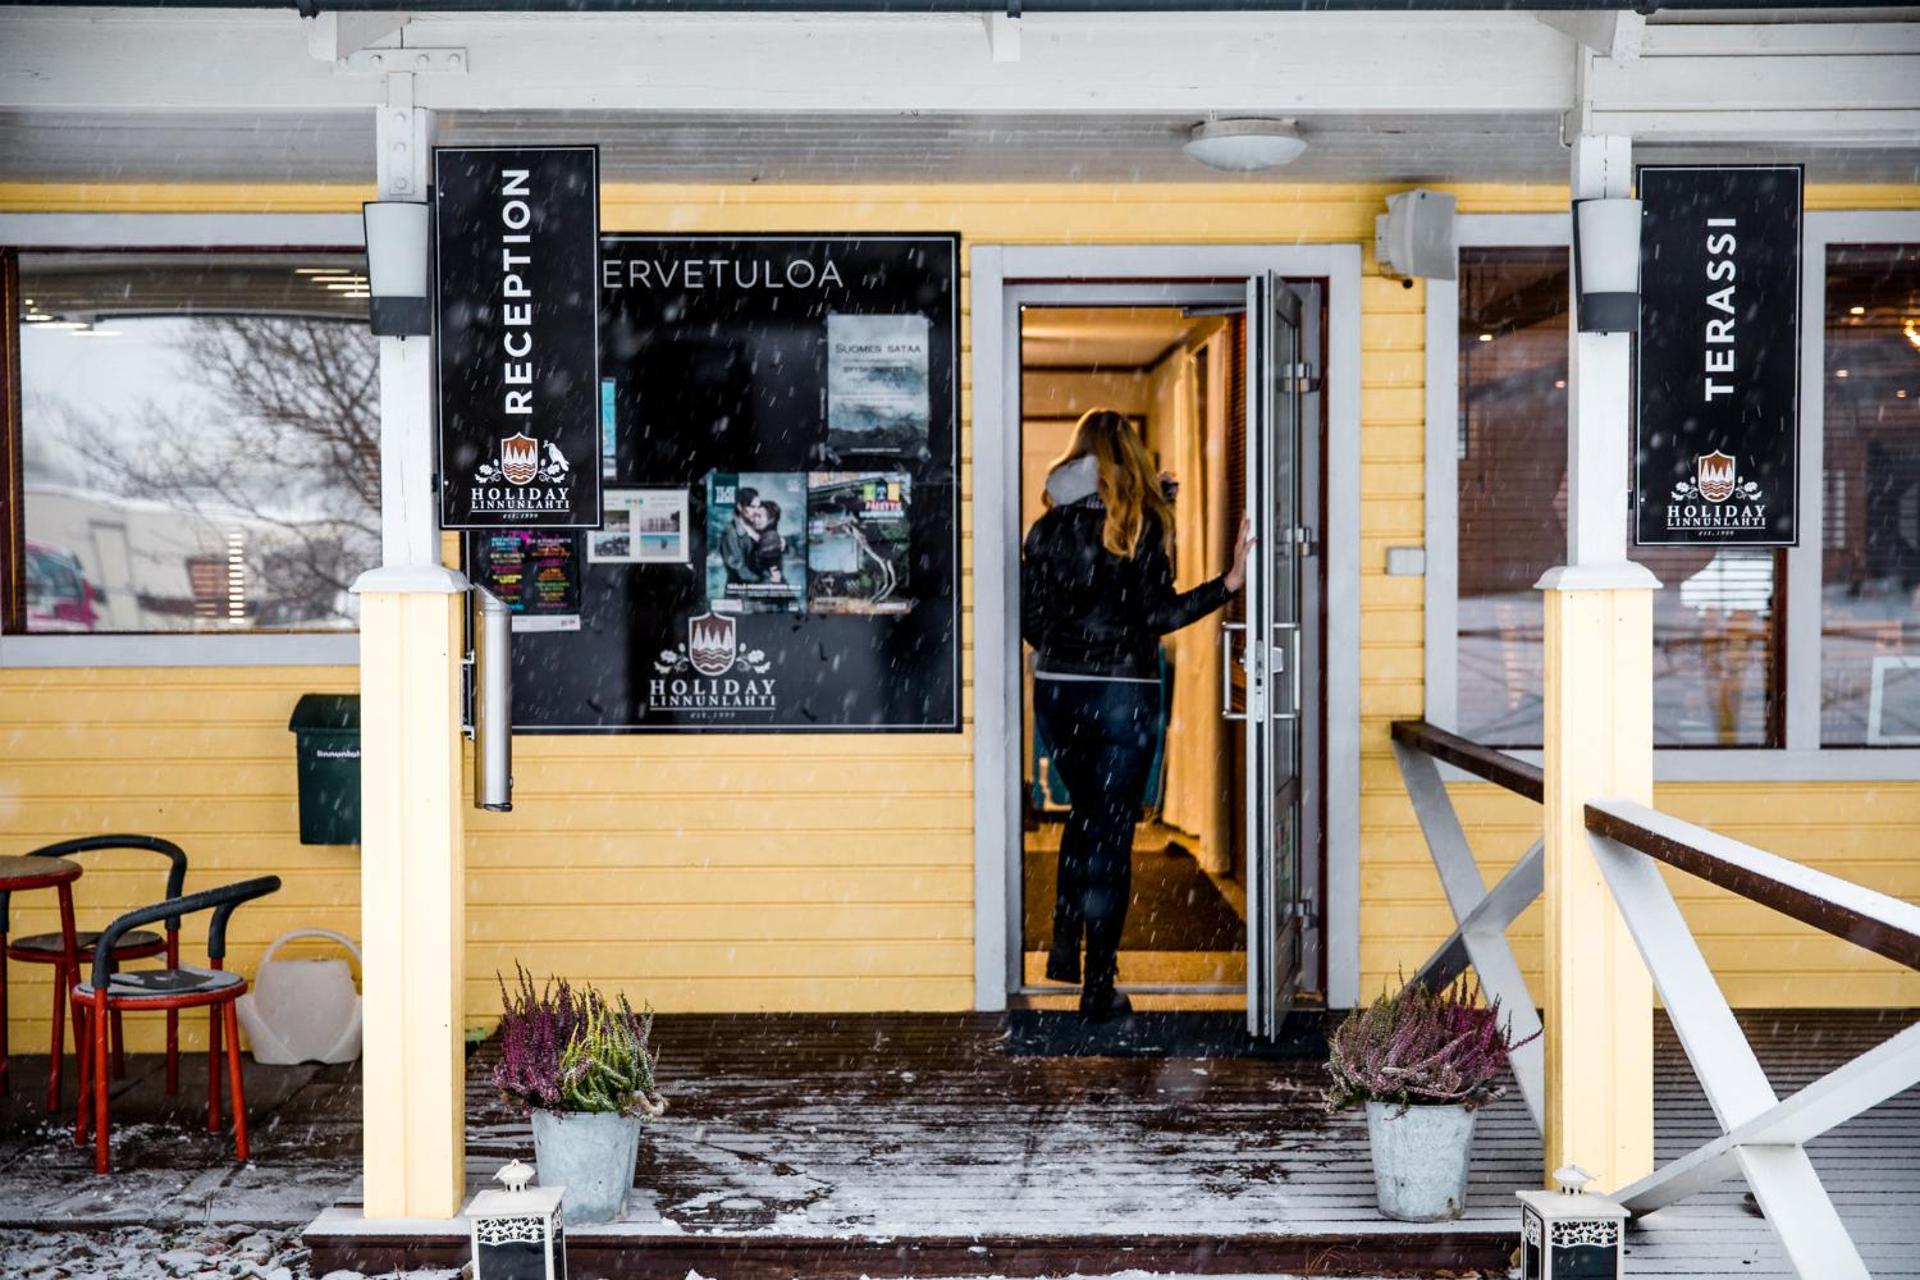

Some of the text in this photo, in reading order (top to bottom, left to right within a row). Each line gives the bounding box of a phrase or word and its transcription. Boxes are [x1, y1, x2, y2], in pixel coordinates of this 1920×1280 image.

[502, 169, 533, 414] RECEPTION
[1705, 218, 1737, 402] TERASSI
[471, 488, 569, 500] HOLIDAY
[471, 501, 570, 509] LINNUNLAHTI
[1667, 505, 1765, 517] HOLIDAY
[1667, 518, 1766, 526] LINNUNLAHTI
[650, 680, 775, 695] HOLIDAY
[650, 695, 776, 706] LINNUNLAHTI
